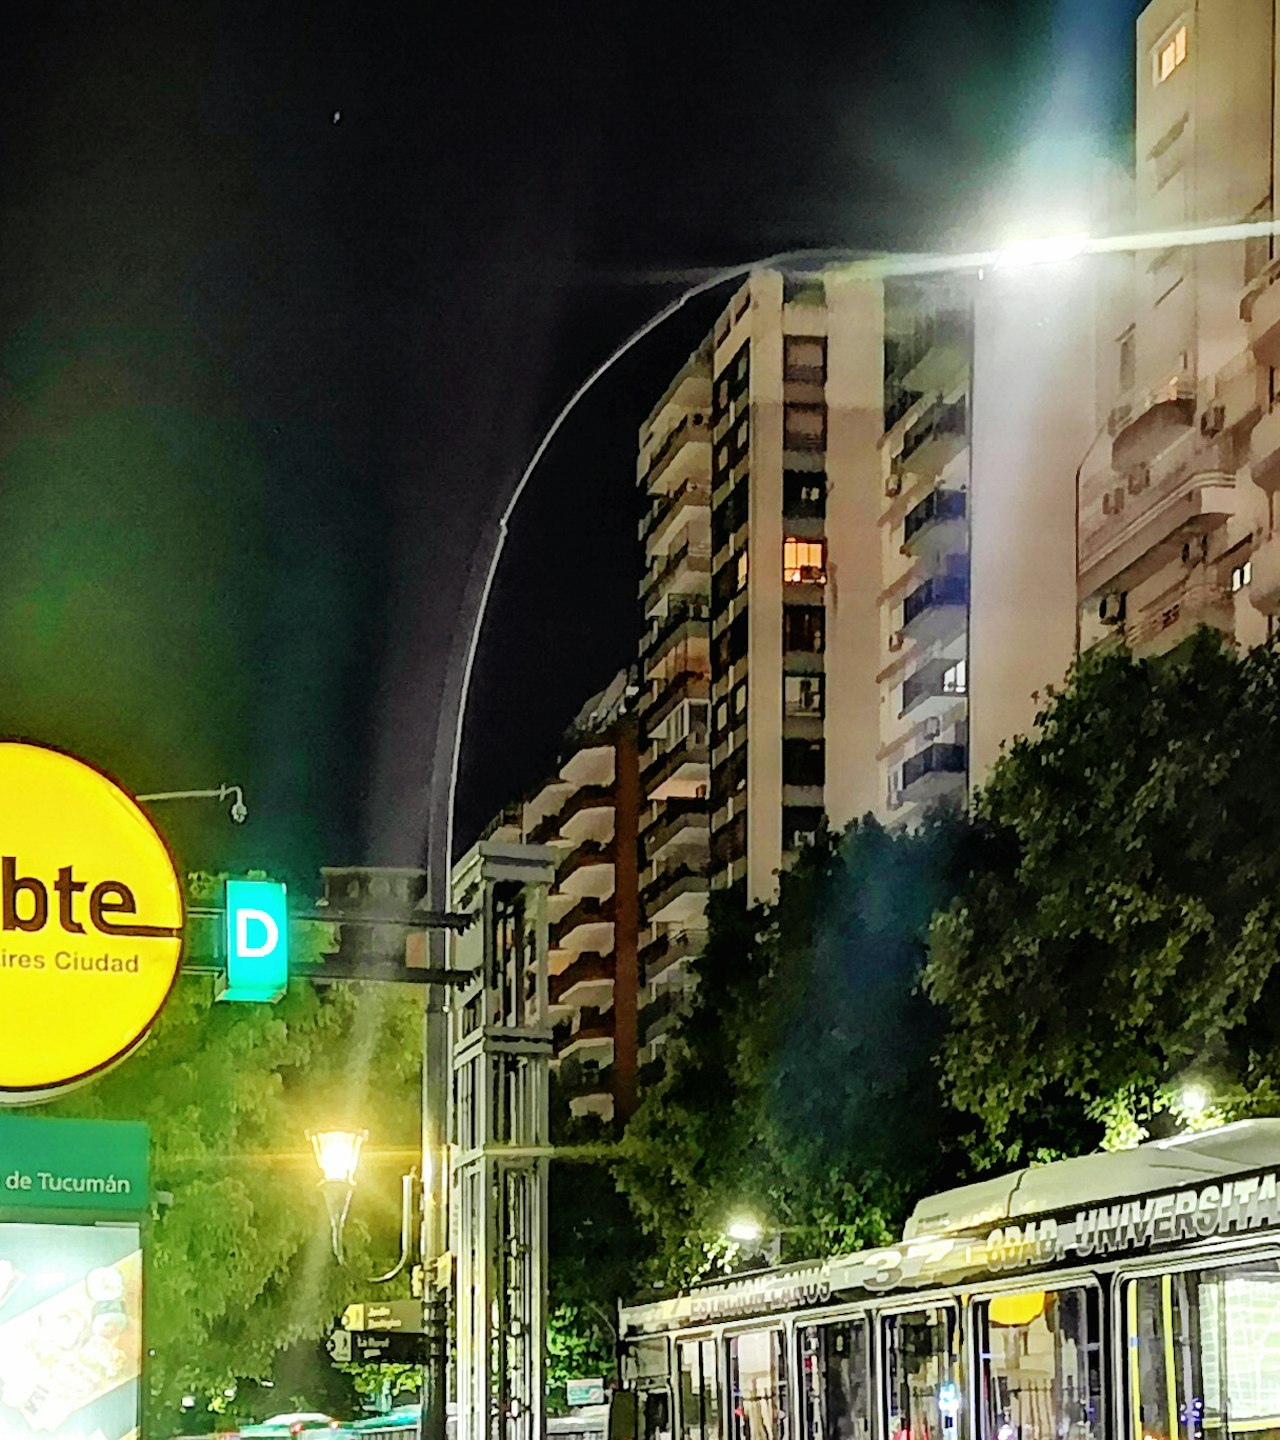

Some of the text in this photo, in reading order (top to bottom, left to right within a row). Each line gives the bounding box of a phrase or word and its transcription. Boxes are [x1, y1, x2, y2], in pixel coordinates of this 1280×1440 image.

[235, 909, 279, 958] D
[54, 951, 139, 973] Ciudad
[5, 1170, 32, 1191] de
[37, 1171, 131, 1194] Tucumán
